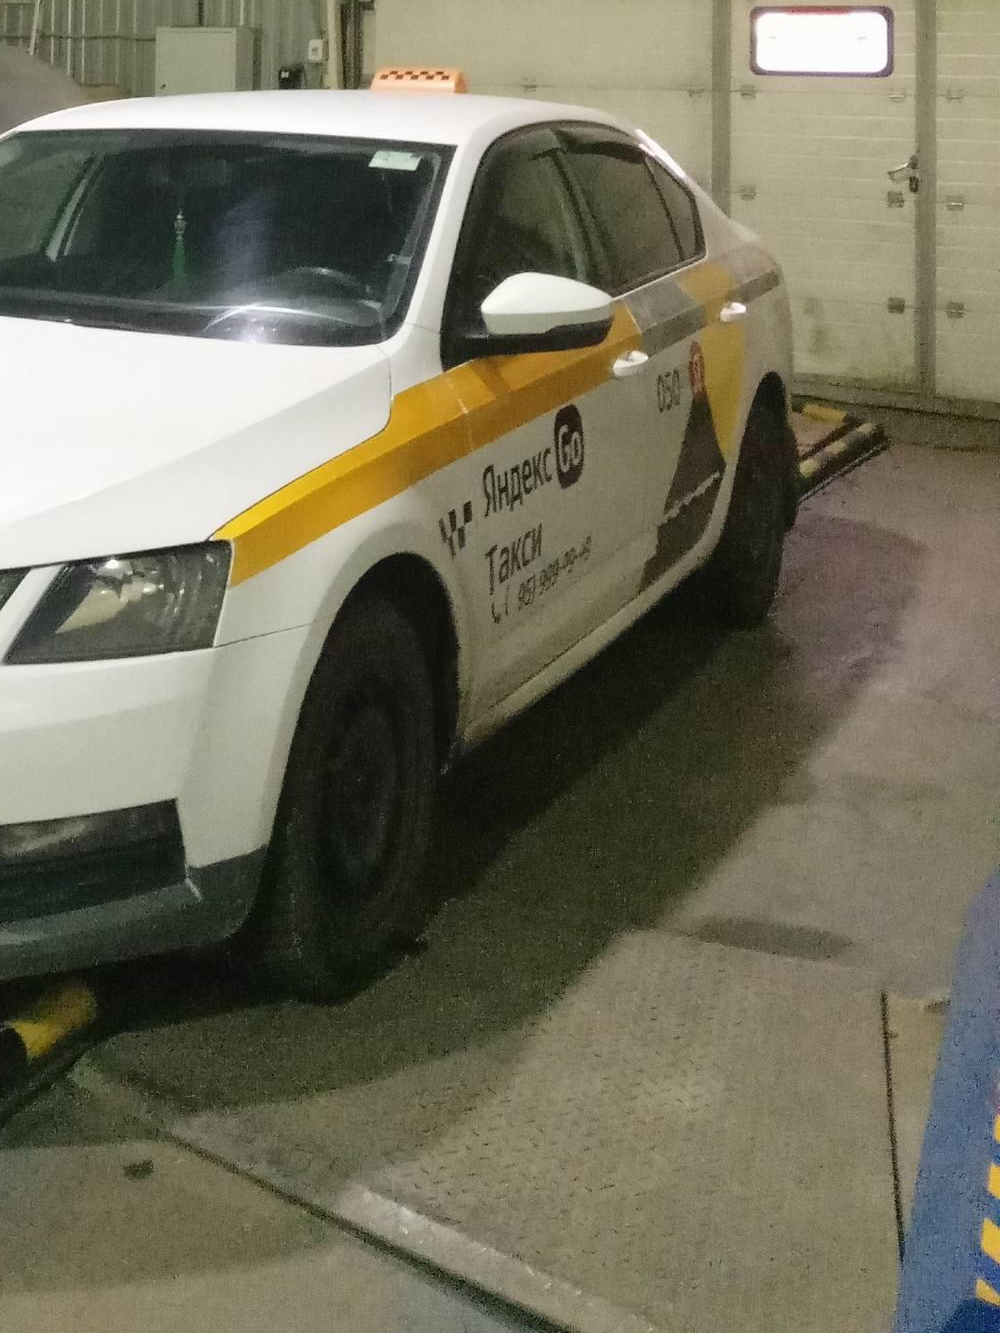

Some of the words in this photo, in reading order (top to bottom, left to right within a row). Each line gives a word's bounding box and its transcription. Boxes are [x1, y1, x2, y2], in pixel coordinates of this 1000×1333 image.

[656, 369, 681, 413] 050
[482, 446, 553, 518] Яндекс
[557, 423, 584, 474] Go
[484, 523, 543, 596] Такси
